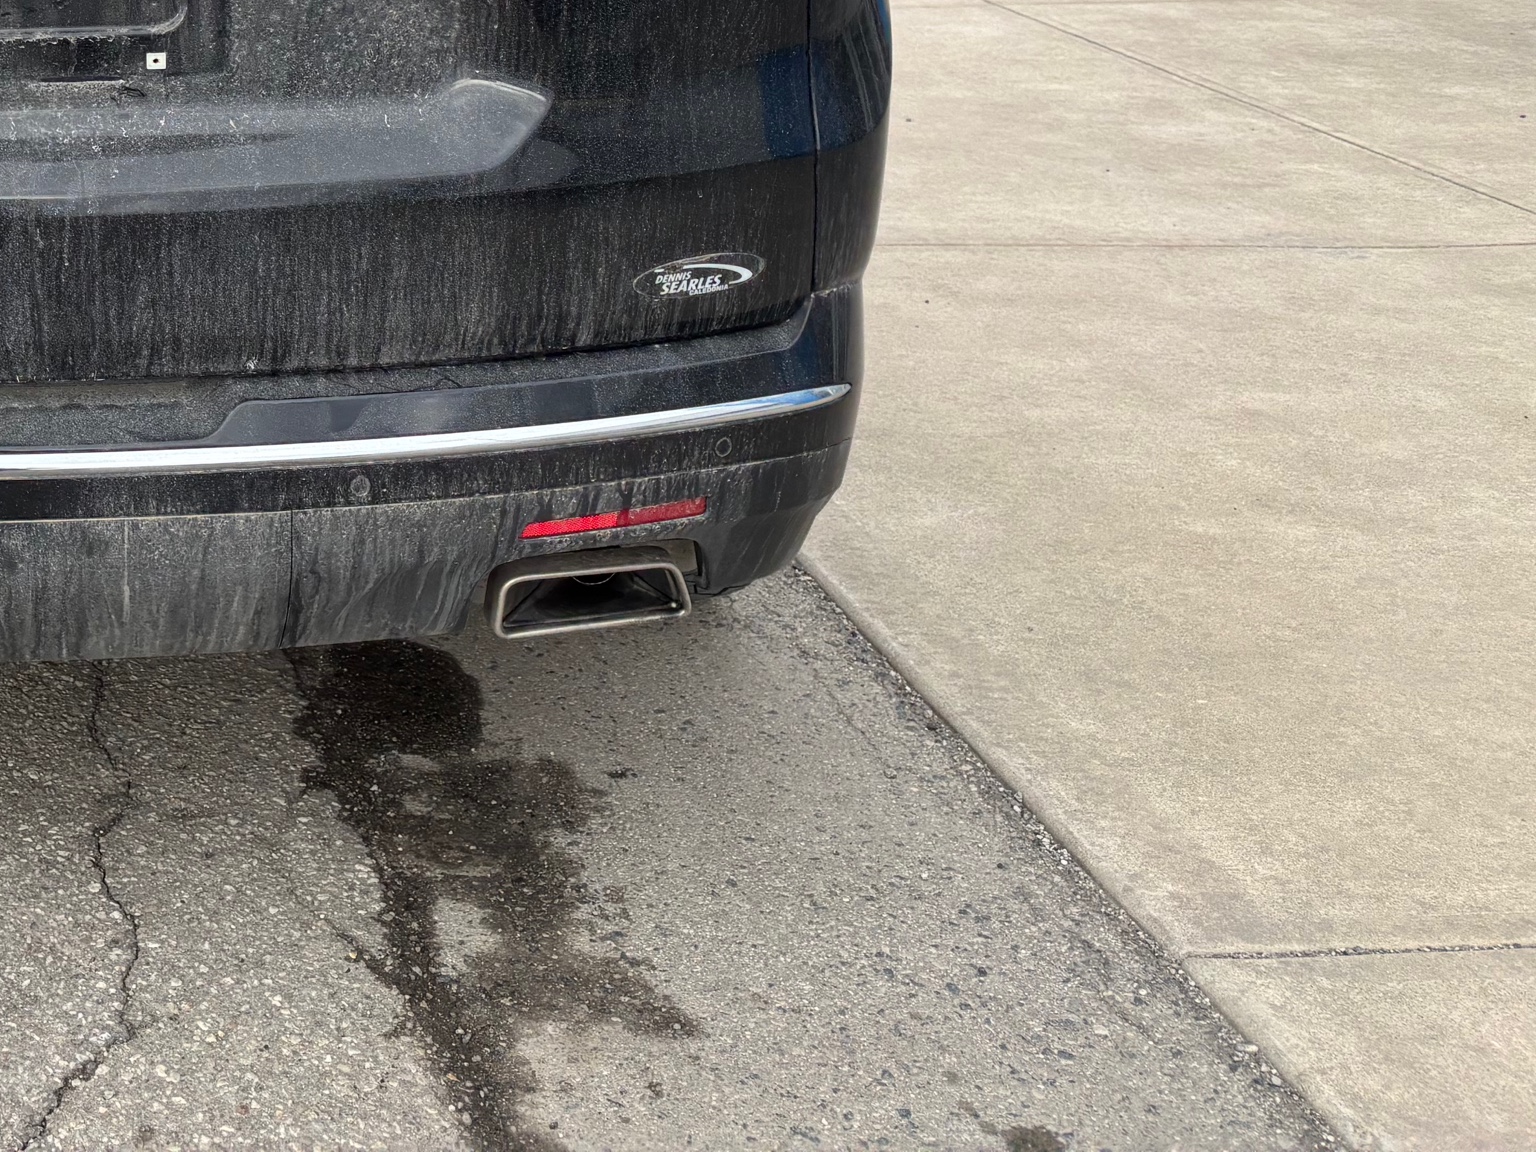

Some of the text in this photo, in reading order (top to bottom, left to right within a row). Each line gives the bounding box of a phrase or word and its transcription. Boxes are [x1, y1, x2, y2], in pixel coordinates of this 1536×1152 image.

[655, 271, 692, 285] DENNIS
[659, 274, 723, 296] SEARLES
[688, 283, 729, 296] CALEDONIA
